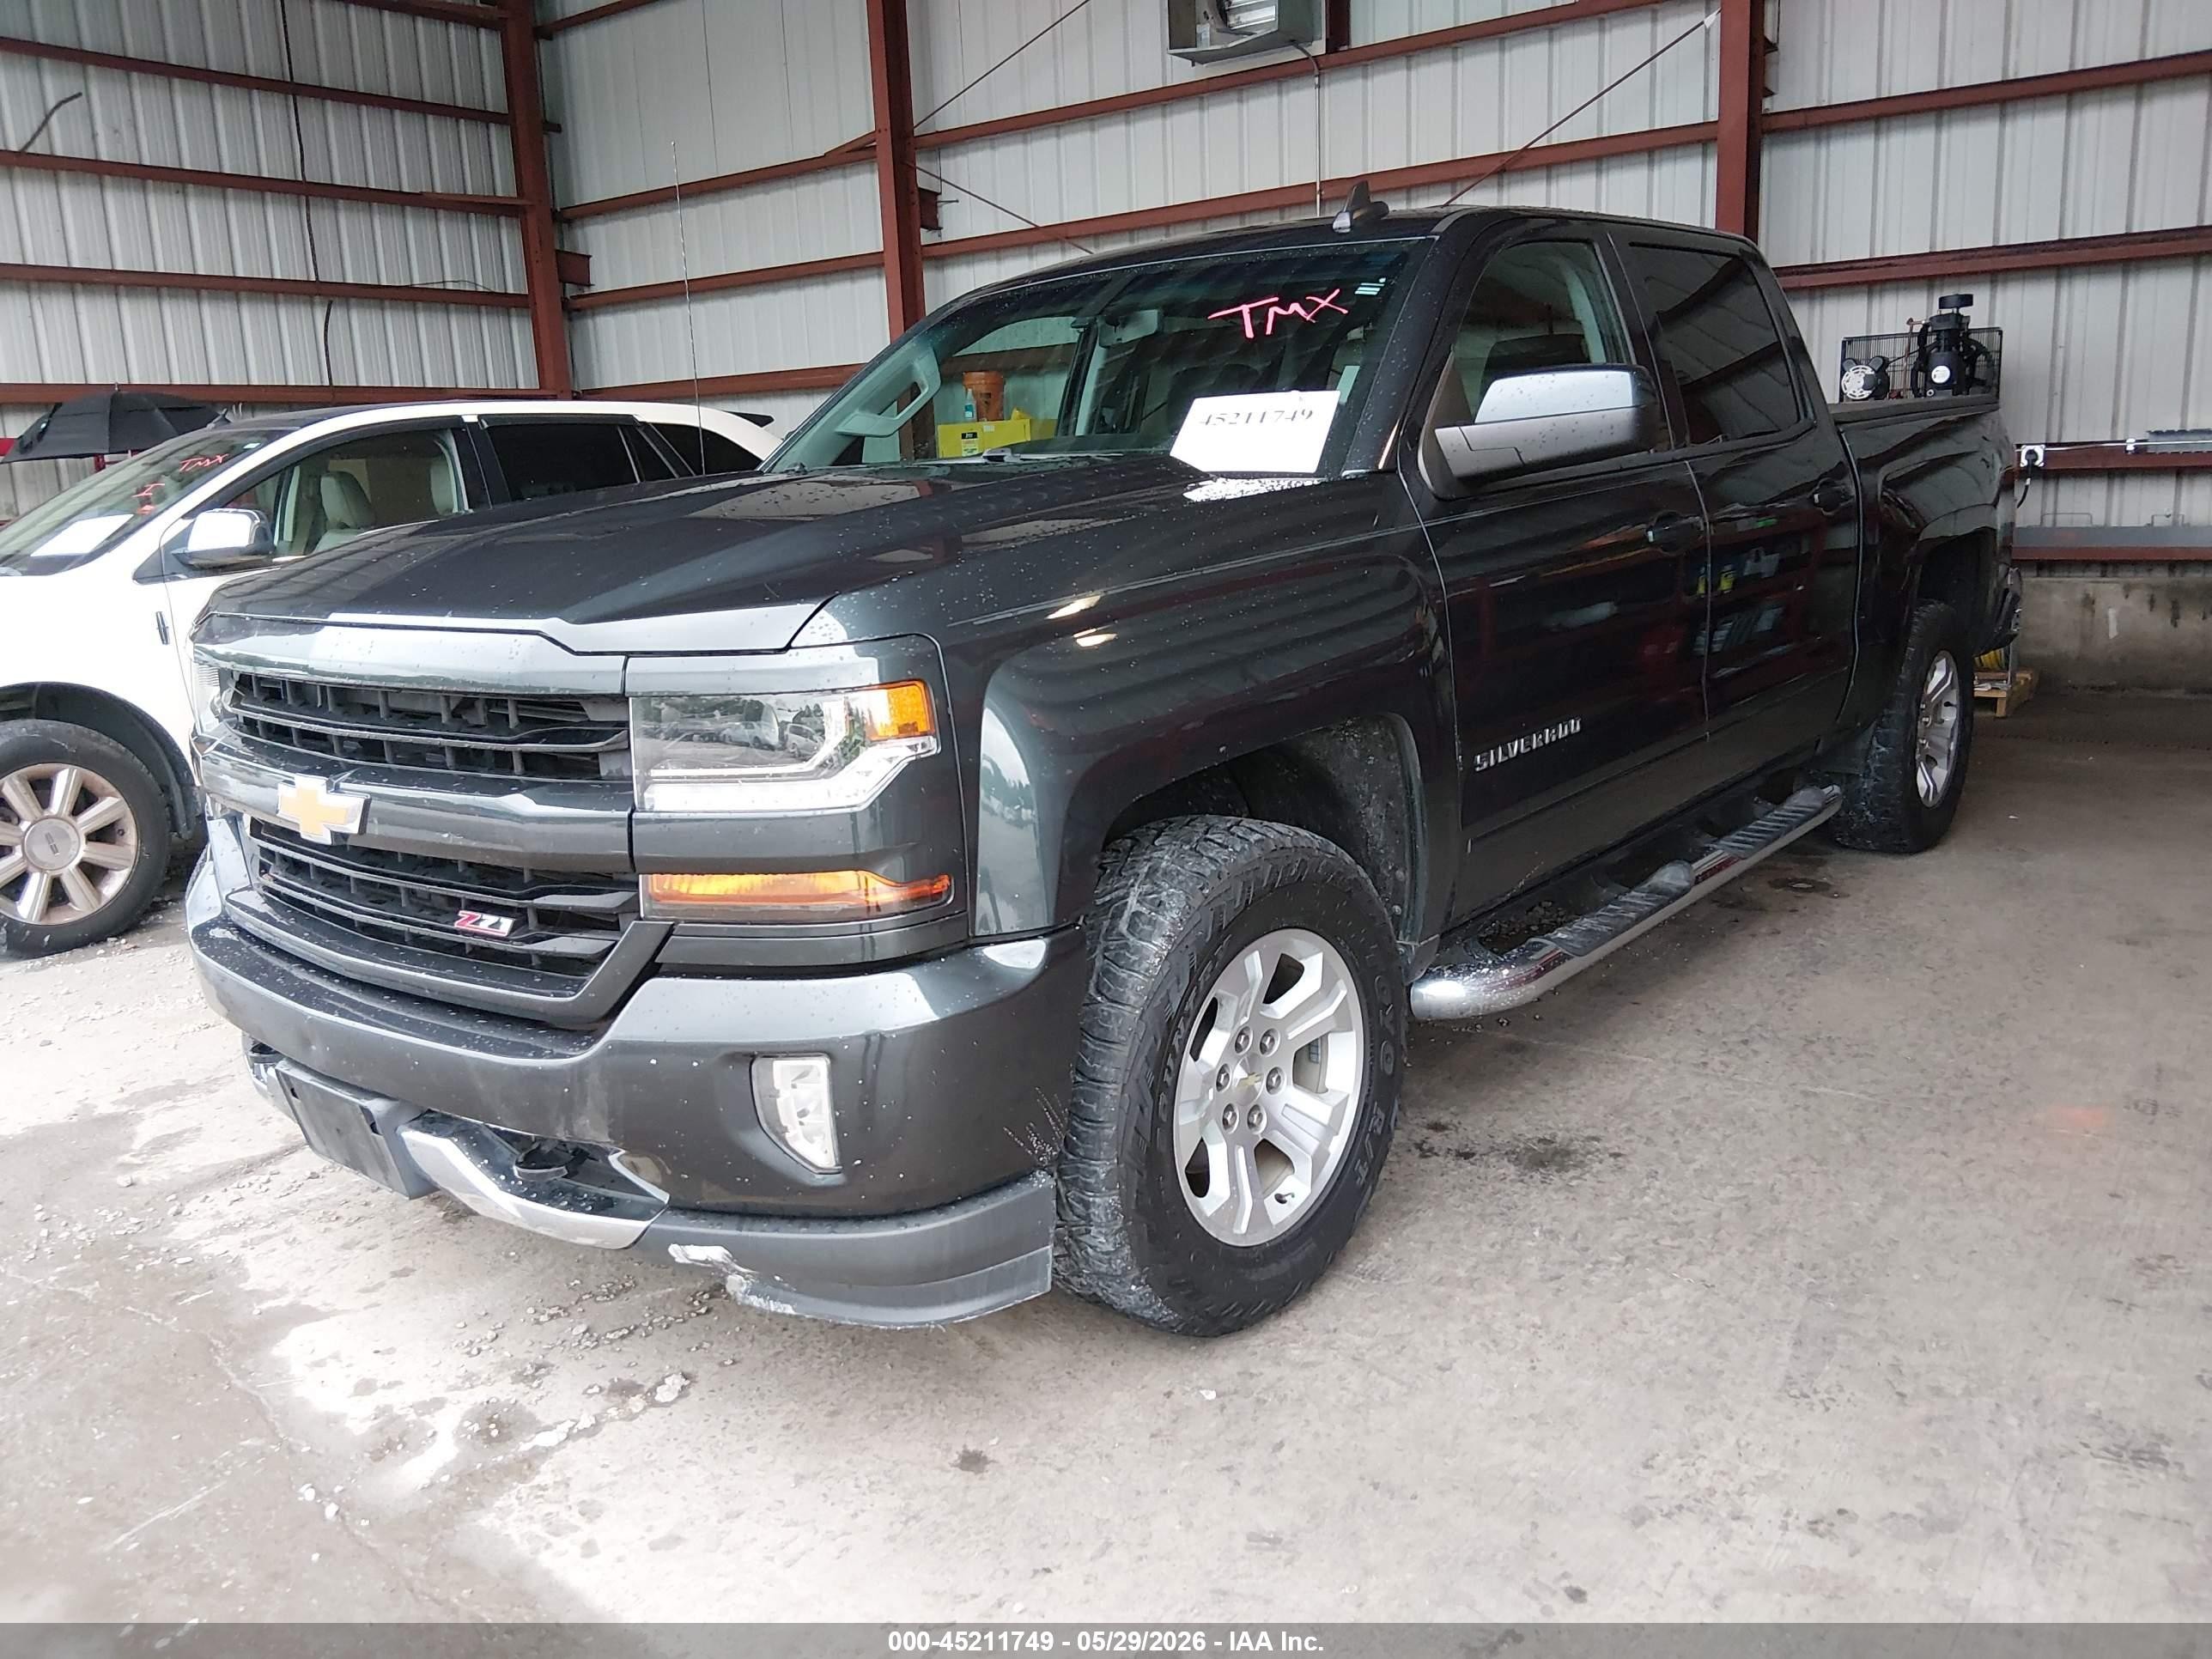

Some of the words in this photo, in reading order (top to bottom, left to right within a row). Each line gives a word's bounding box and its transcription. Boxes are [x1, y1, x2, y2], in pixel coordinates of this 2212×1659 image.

[1206, 289, 1349, 339] TMX
[1201, 409, 1314, 427] 45211749
[1474, 716, 1582, 772] SILVERADO
[454, 909, 515, 937] Z71
